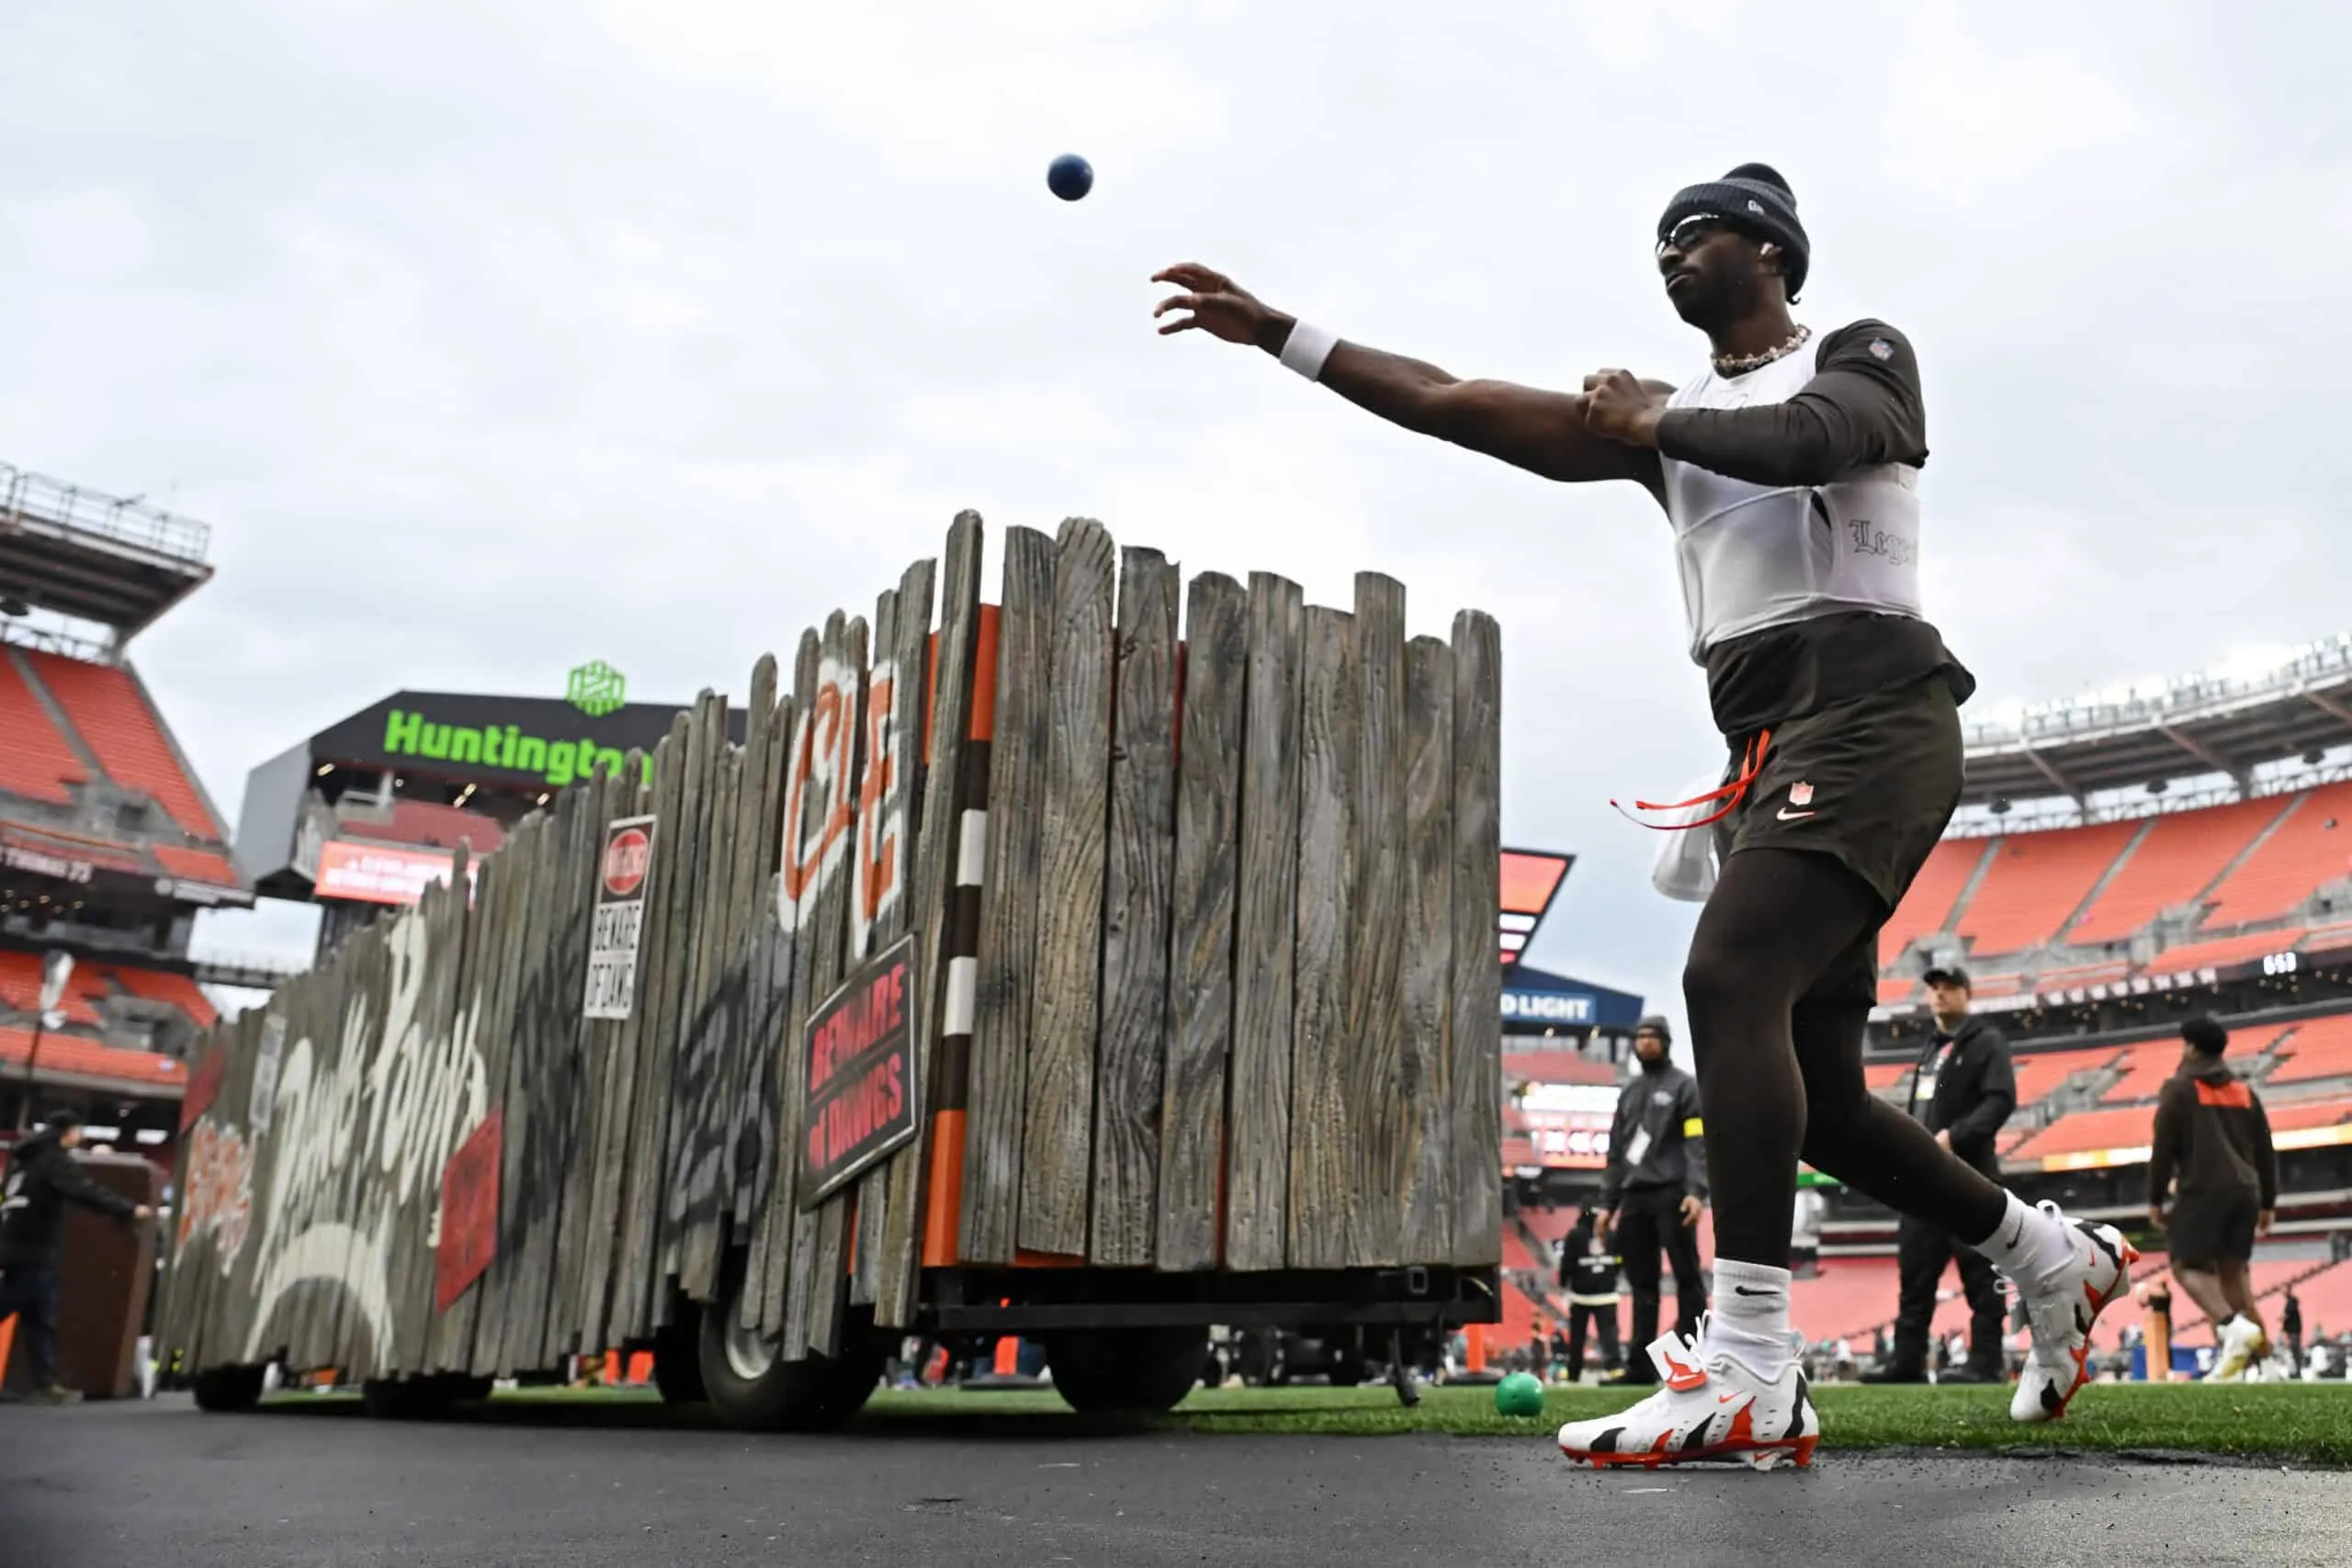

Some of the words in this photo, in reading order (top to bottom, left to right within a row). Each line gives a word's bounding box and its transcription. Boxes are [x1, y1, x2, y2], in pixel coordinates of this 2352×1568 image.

[594, 905, 640, 952] BEWARE
[810, 961, 905, 1093] BEWARE
[1519, 994, 1590, 1020] LIGHT
[828, 1053, 903, 1163] DAWGS
